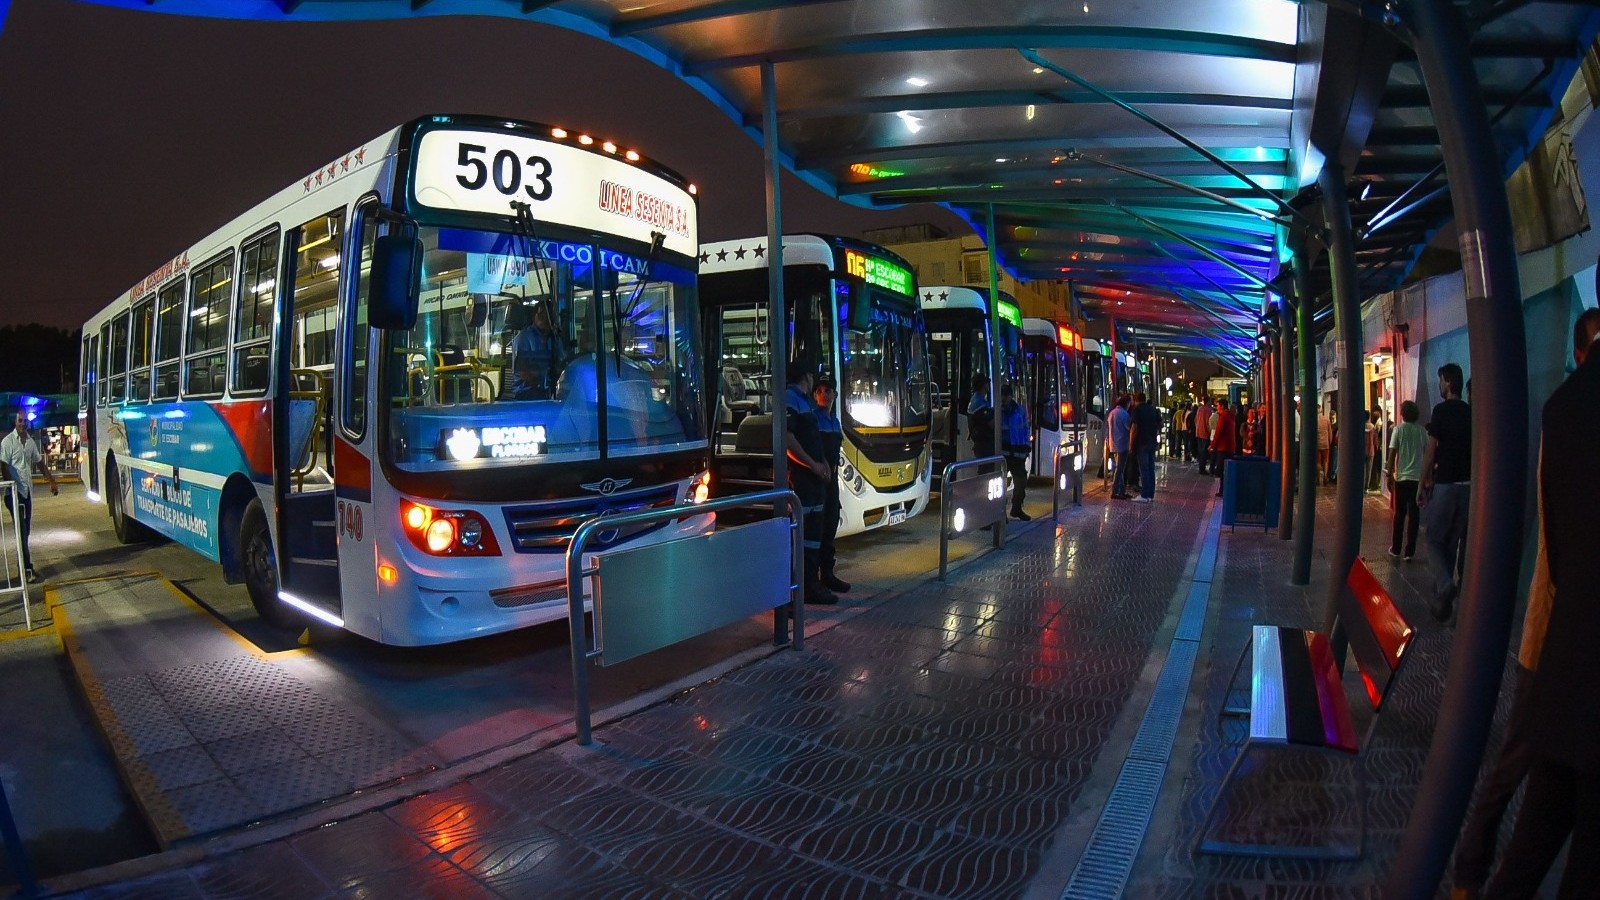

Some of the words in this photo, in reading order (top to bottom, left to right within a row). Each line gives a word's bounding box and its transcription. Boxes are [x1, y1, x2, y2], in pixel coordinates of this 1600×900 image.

[455, 142, 553, 201] 503
[599, 179, 634, 218] LINEA
[635, 190, 674, 232] SESENTA
[182, 489, 192, 508] DE
[165, 506, 172, 523] DE
[172, 509, 208, 538] PASAJEROS
[337, 500, 364, 542] 740
